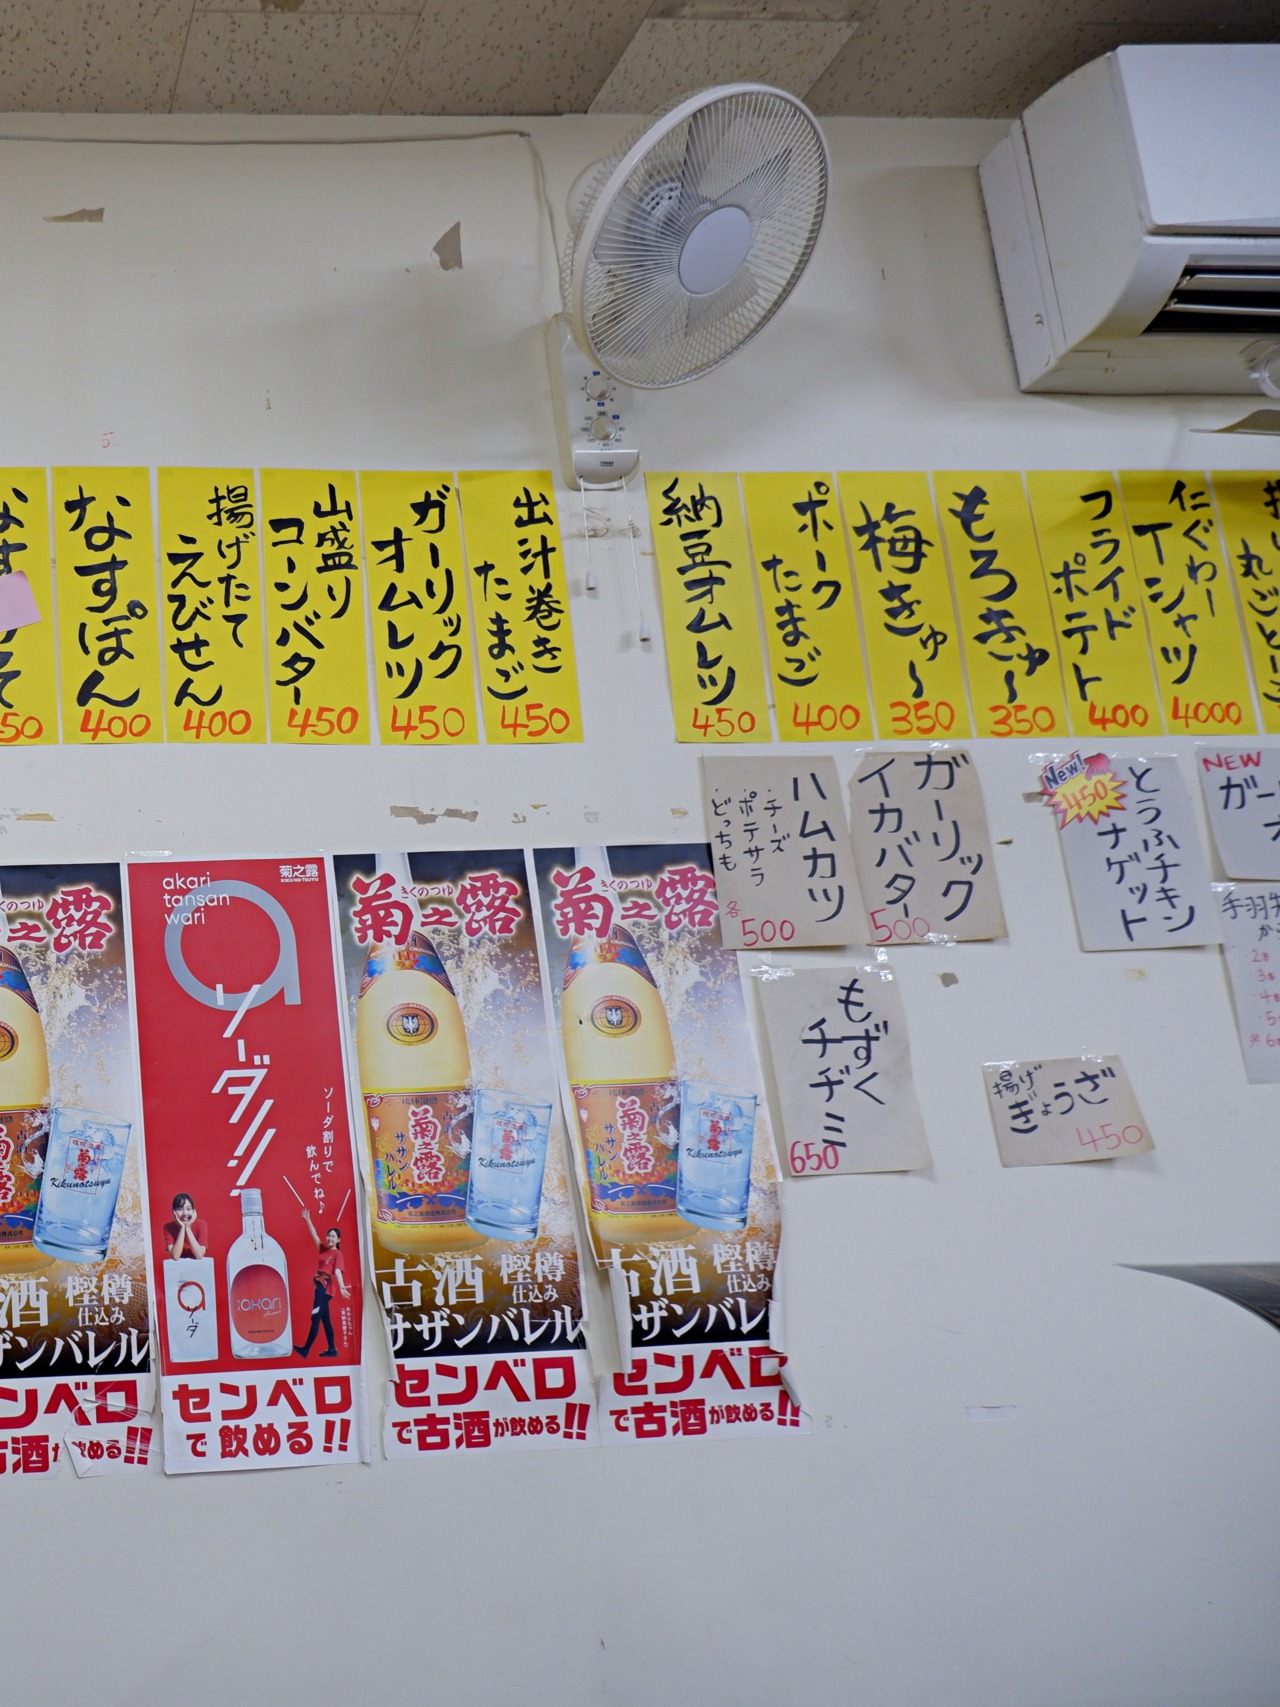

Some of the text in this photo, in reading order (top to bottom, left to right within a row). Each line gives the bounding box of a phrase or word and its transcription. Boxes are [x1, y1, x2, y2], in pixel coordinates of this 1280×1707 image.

[206, 485, 257, 649] 揚げたて
[312, 483, 360, 621] 山盛り
[791, 481, 842, 611] ポーク
[1079, 490, 1137, 643] フライド
[65, 484, 148, 707] なすぽん
[411, 482, 468, 680] ガーリック
[512, 486, 566, 675] 出汁巻き
[659, 477, 737, 707] 納豆オムレツ
[1133, 522, 1197, 686] Tシャツ
[167, 534, 223, 708] えびせん
[269, 517, 326, 706] コーンバター
[371, 527, 425, 701] オムレツ
[474, 560, 529, 701] たまご
[761, 554, 821, 688] たまご
[1049, 553, 1102, 702] ポテト
[79, 712, 152, 742] 400
[182, 709, 253, 739] 400
[286, 706, 359, 738] 450
[391, 706, 466, 741] 450
[500, 703, 571, 737] 450
[691, 707, 757, 738] 450
[791, 703, 861, 733] 400
[889, 701, 956, 736] 350
[989, 704, 1057, 740] 350
[1087, 703, 1150, 730] 400
[1171, 697, 1242, 728] 4000
[1042, 752, 1086, 793] New!
[1201, 751, 1262, 772] NEW
[1061, 779, 1110, 811] 450
[1219, 774, 1280, 811] ガー
[792, 772, 845, 923] ハムカツ
[857, 757, 921, 919] イカバター
[913, 753, 984, 922] ガーリック
[1127, 766, 1196, 933] とうふチキン
[162, 872, 211, 890] akari
[279, 864, 319, 878] 菊之露
[1096, 822, 1148, 942] ナゲット
[163, 893, 230, 908] tansan
[164, 907, 206, 925] wari
[352, 872, 523, 947] 菊之露
[552, 866, 719, 939] 菊之露
[724, 900, 796, 948] 各 500
[869, 908, 931, 943] 500
[836, 978, 889, 1105] もずく
[801, 1017, 852, 1148] チヂミ
[991, 1063, 1043, 1099] 揚げ
[1007, 1066, 1117, 1135] ぎょうざ
[322, 1087, 334, 1172] ソーダ割りで
[411, 1107, 444, 1182] 菊之露
[1074, 1123, 1145, 1153] 450
[477, 1157, 536, 1169] Kikunotsuyu
[789, 1141, 840, 1174] 650
[50, 1177, 112, 1190] Kikunotsuyu
[375, 1254, 486, 1310] 古酒
[512, 1284, 559, 1304] 仕込み
[726, 1273, 771, 1294] 仕込み
[77, 1306, 126, 1327] 仕込み
[385, 1304, 586, 1351] サザンバレル
[631, 1297, 770, 1341] ザンバレ
[172, 1375, 352, 1424] センベロ
[394, 1355, 577, 1408] センベロ
[186, 1418, 352, 1459] で飲める!!
